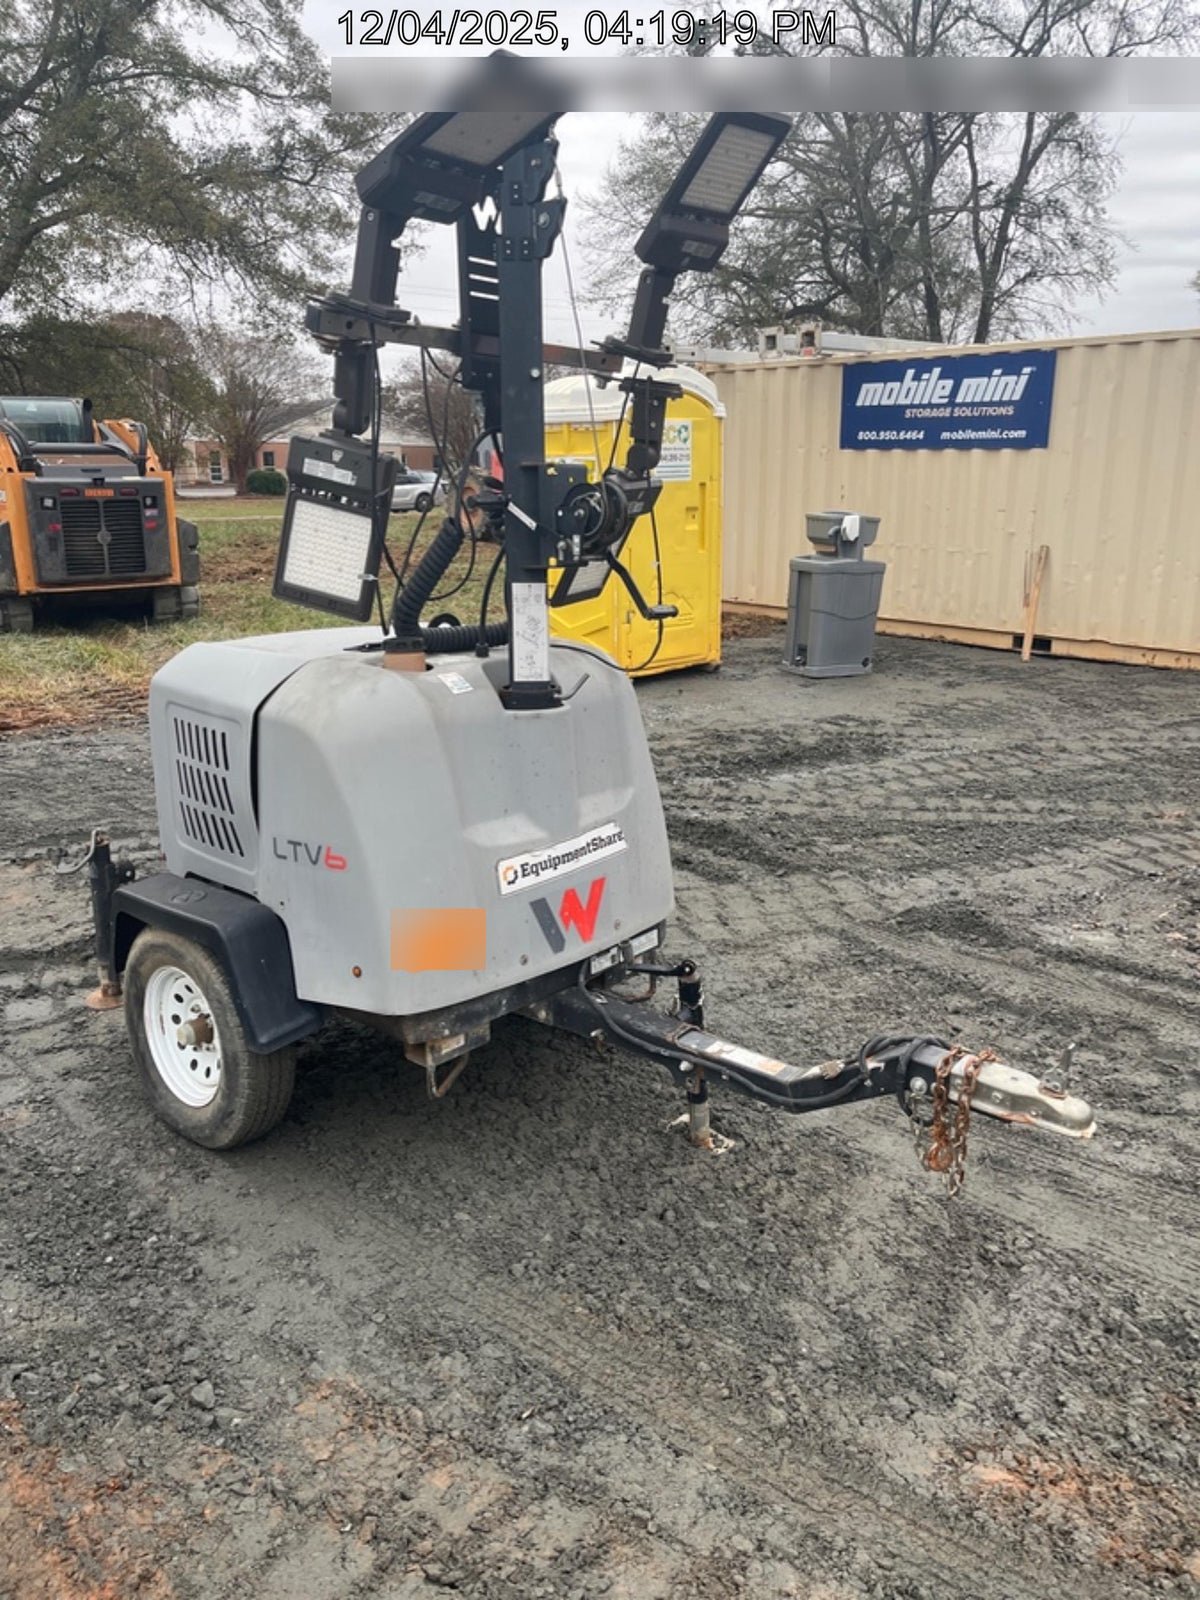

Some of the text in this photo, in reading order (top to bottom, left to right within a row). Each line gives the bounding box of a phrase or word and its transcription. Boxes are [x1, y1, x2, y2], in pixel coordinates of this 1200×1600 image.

[856, 367, 1032, 406] mobile mini
[904, 405, 1015, 418] STORAGE SOLUTIONS
[857, 430, 925, 441] 800.950.6464
[940, 428, 1027, 440] mobilemini.com
[272, 837, 347, 870] LTV6
[519, 830, 625, 878] EquipmentShare
